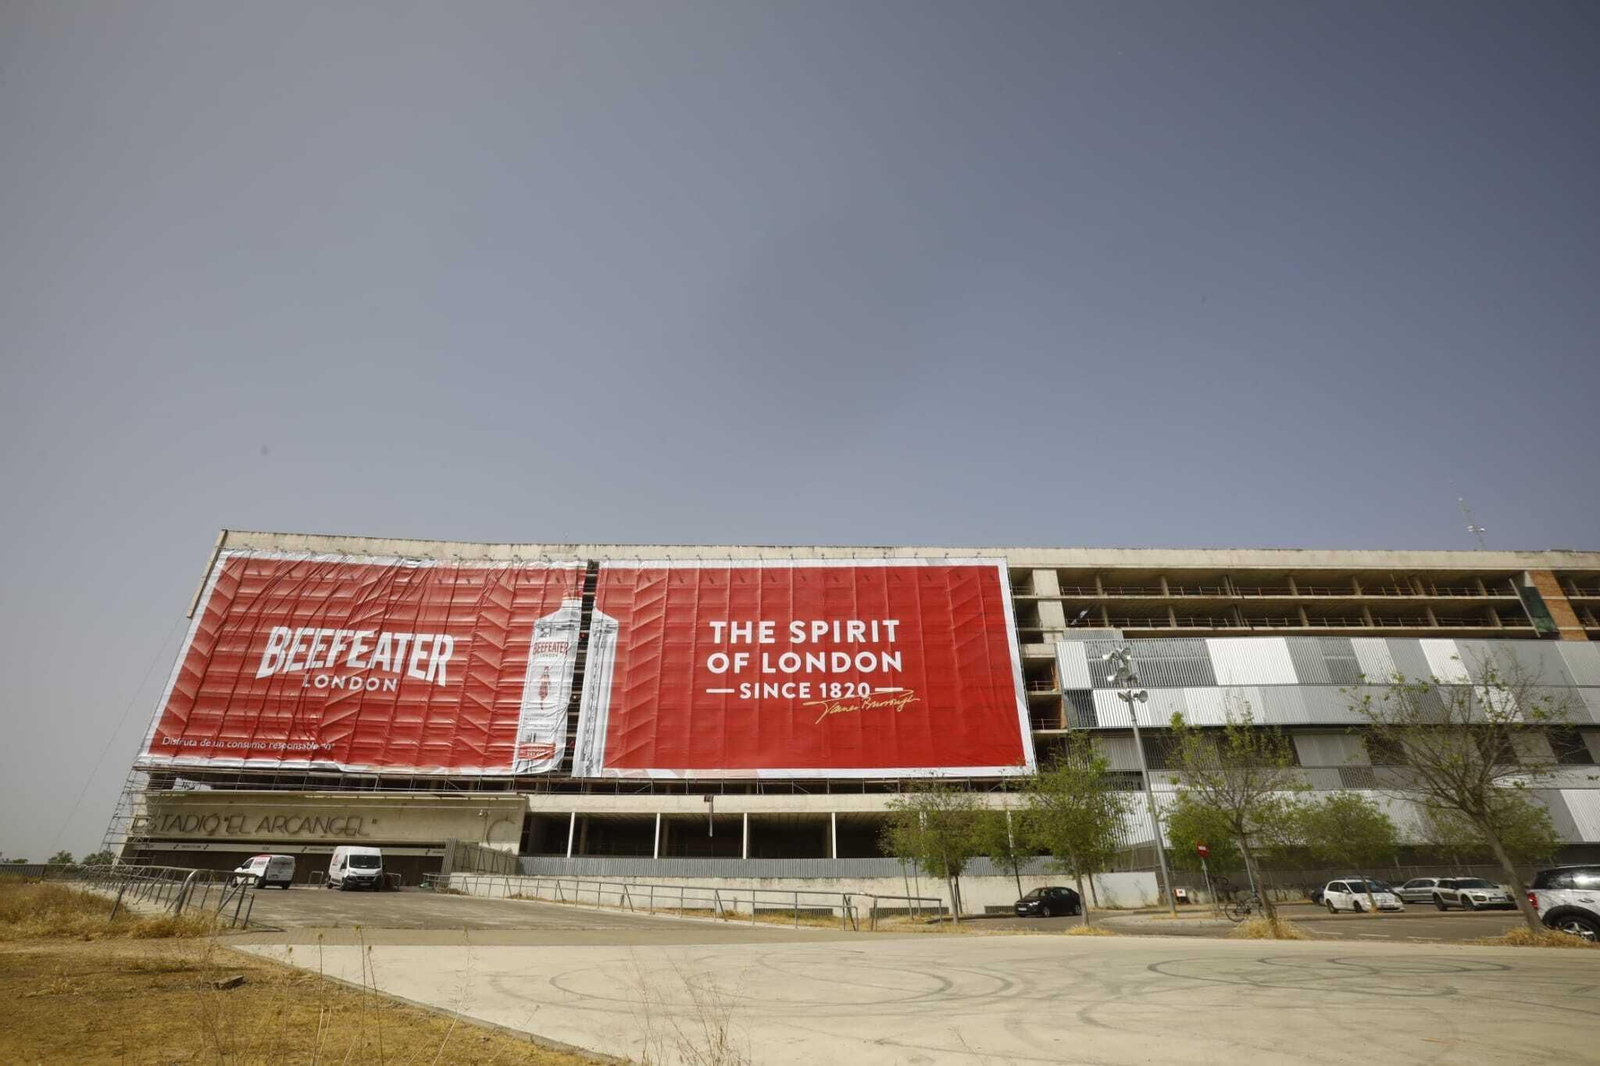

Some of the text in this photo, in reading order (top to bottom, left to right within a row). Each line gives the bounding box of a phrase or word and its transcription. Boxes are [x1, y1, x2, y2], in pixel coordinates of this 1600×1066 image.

[709, 619, 900, 644] THE SPIRIT
[255, 626, 454, 687] BEEFEATER
[533, 641, 569, 655] BEEFEATER
[706, 651, 902, 674] OF LONDON
[302, 674, 398, 692] LONDON
[739, 682, 871, 699] SINCE 1820
[162, 736, 197, 746] Disfruta
[200, 738, 211, 747] de
[212, 740, 225, 748] un
[226, 741, 267, 749] consumo
